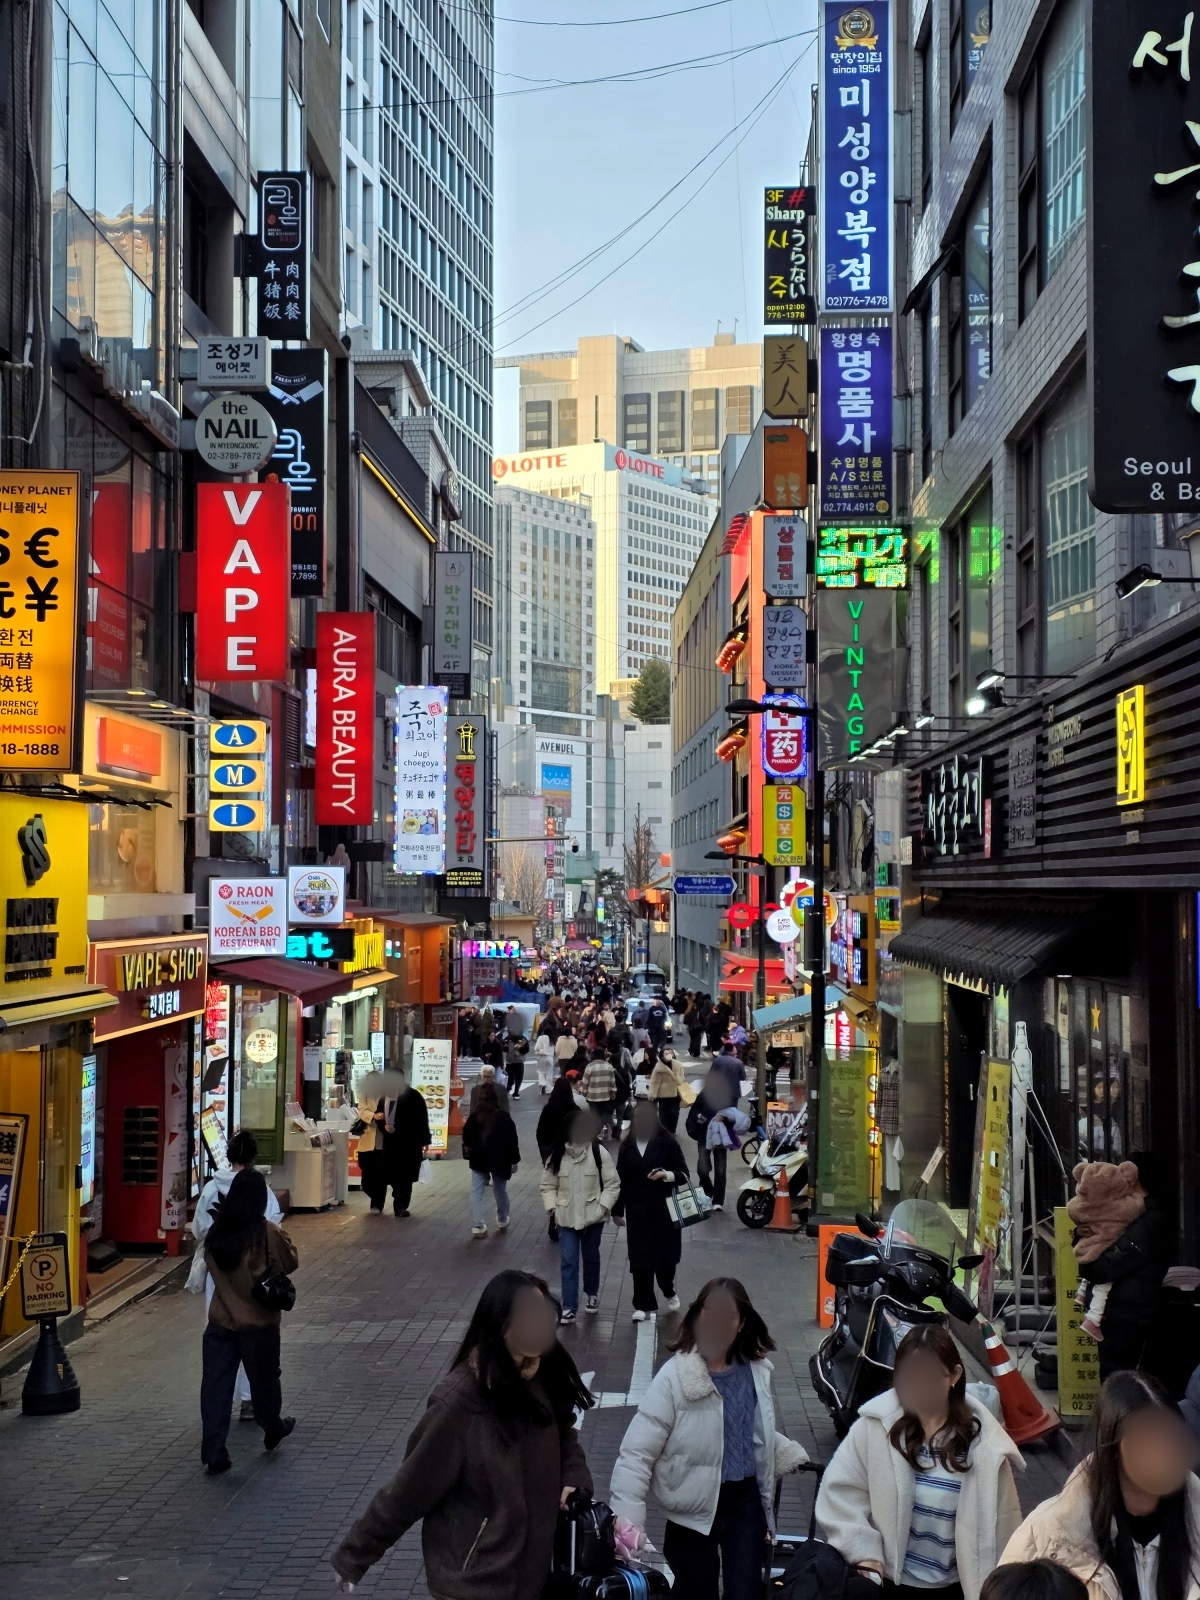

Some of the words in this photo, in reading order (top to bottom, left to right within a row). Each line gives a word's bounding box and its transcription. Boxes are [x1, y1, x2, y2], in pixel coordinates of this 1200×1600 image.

[833, 66, 857, 74] since
[859, 65, 881, 73] 1954
[837, 79, 877, 291] 미성양복점
[766, 190, 784, 203] 3F
[766, 205, 806, 224] Sharp
[790, 229, 806, 299] うらない
[827, 296, 888, 306] 02)776-7478
[832, 332, 880, 348] 황영숙
[207, 343, 259, 360] 조성기
[771, 343, 800, 407] 美人
[221, 401, 248, 415] the
[837, 351, 877, 453] 명품사
[205, 419, 268, 439] NAIL
[511, 453, 567, 473] LOTTE
[629, 459, 664, 479] LOTTE
[831, 457, 882, 468] 수입명품
[1124, 458, 1191, 476] Seoul
[0, 486, 25, 496] NEY
[27, 486, 72, 496] PLANET
[1150, 482, 1165, 500] &
[824, 503, 875, 513] 02.774.4912
[777, 526, 795, 580] 상품권
[223, 490, 263, 671] VAPE
[444, 585, 461, 650] 반지대학
[333, 628, 358, 703] AURA
[443, 661, 460, 670] 4F
[847, 600, 864, 755] VINTAGE
[0, 725, 66, 735] MMISSION
[405, 730, 438, 742] 최고야
[541, 741, 574, 754] AVENUEL
[770, 732, 798, 758] 药
[332, 710, 357, 815] BEAUTY
[414, 750, 430, 759] Jugi
[403, 759, 439, 768] choegoya
[778, 789, 791, 800] 元
[237, 886, 273, 898] RAON
[215, 927, 257, 938] KOREAN
[259, 927, 281, 937] BBQ
[220, 938, 277, 947] RESTAURANT
[287, 932, 334, 958] at
[124, 952, 163, 991] VAPE
[170, 947, 203, 983] SHOP
[474, 969, 496, 979] 부동산
[839, 1026, 850, 1062] PHARM
[81, 1071, 95, 1087] APE
[36, 1282, 54, 1292] NO
[27, 1291, 65, 1302] PARKING
[1077, 1370, 1098, 1380] 驾驶
